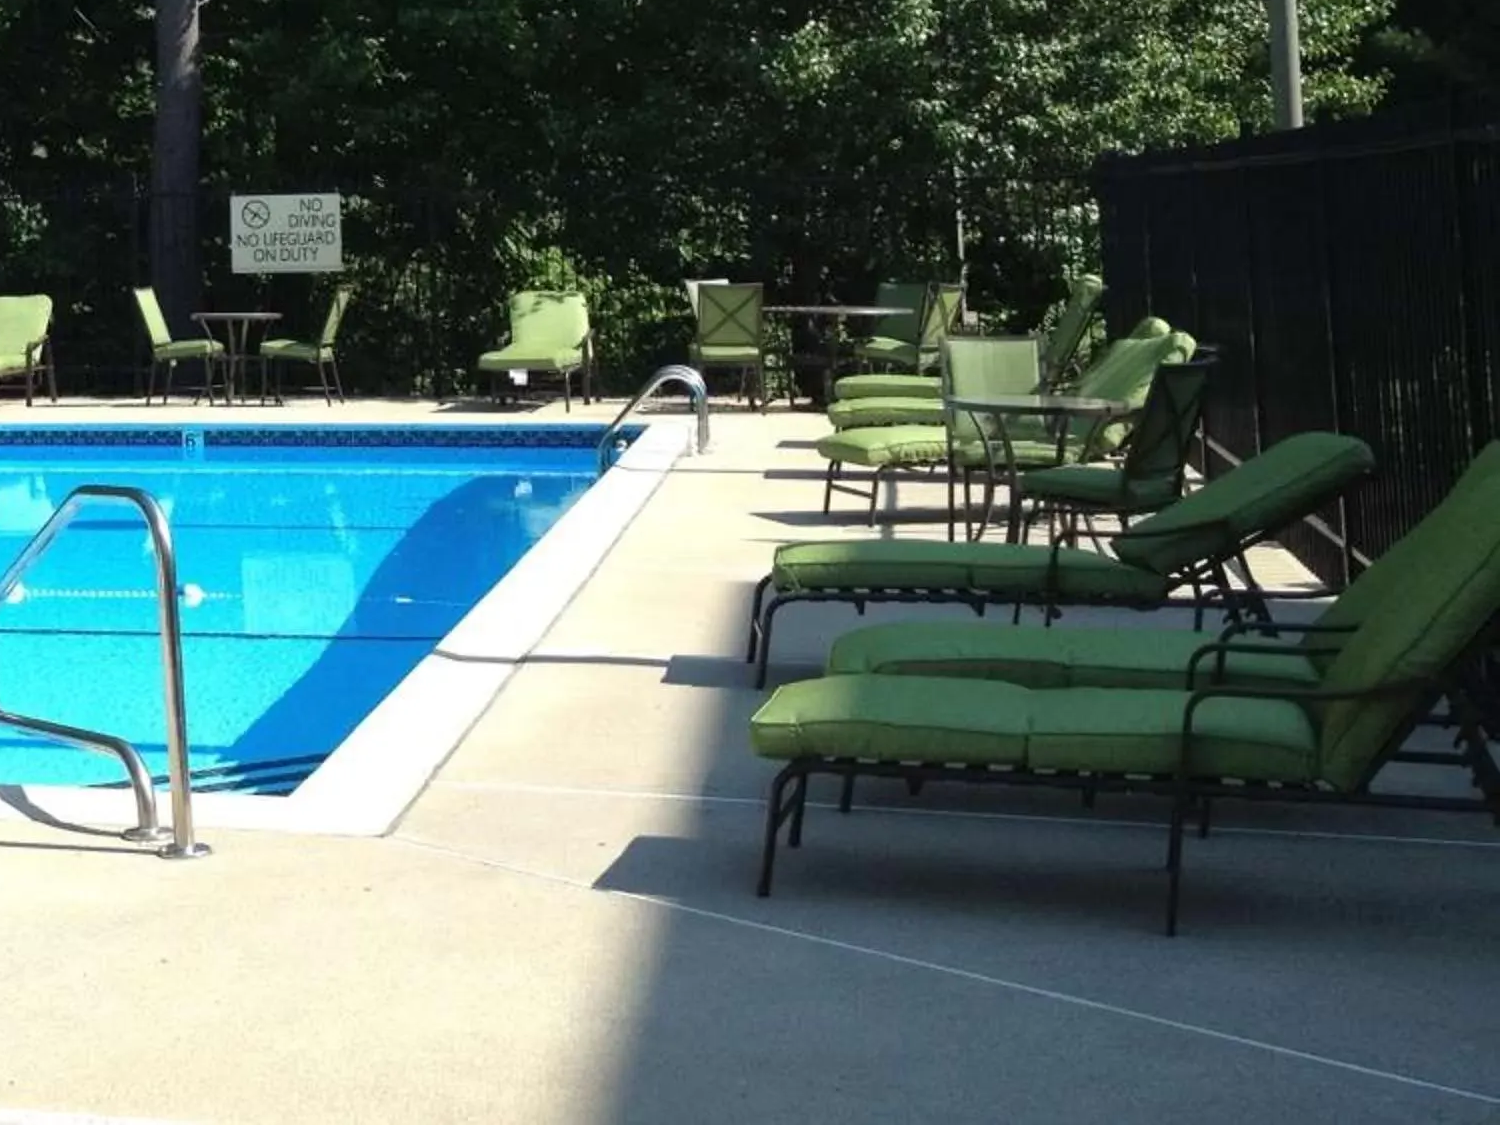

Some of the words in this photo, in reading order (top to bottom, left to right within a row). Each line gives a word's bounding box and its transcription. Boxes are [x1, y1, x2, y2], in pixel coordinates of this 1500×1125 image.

[300, 197, 322, 212] NO
[288, 214, 336, 228] DIVING
[236, 233, 259, 247] NO
[263, 230, 335, 247] LIFEGUARD
[253, 248, 276, 262] ON
[280, 247, 318, 262] DUTY
